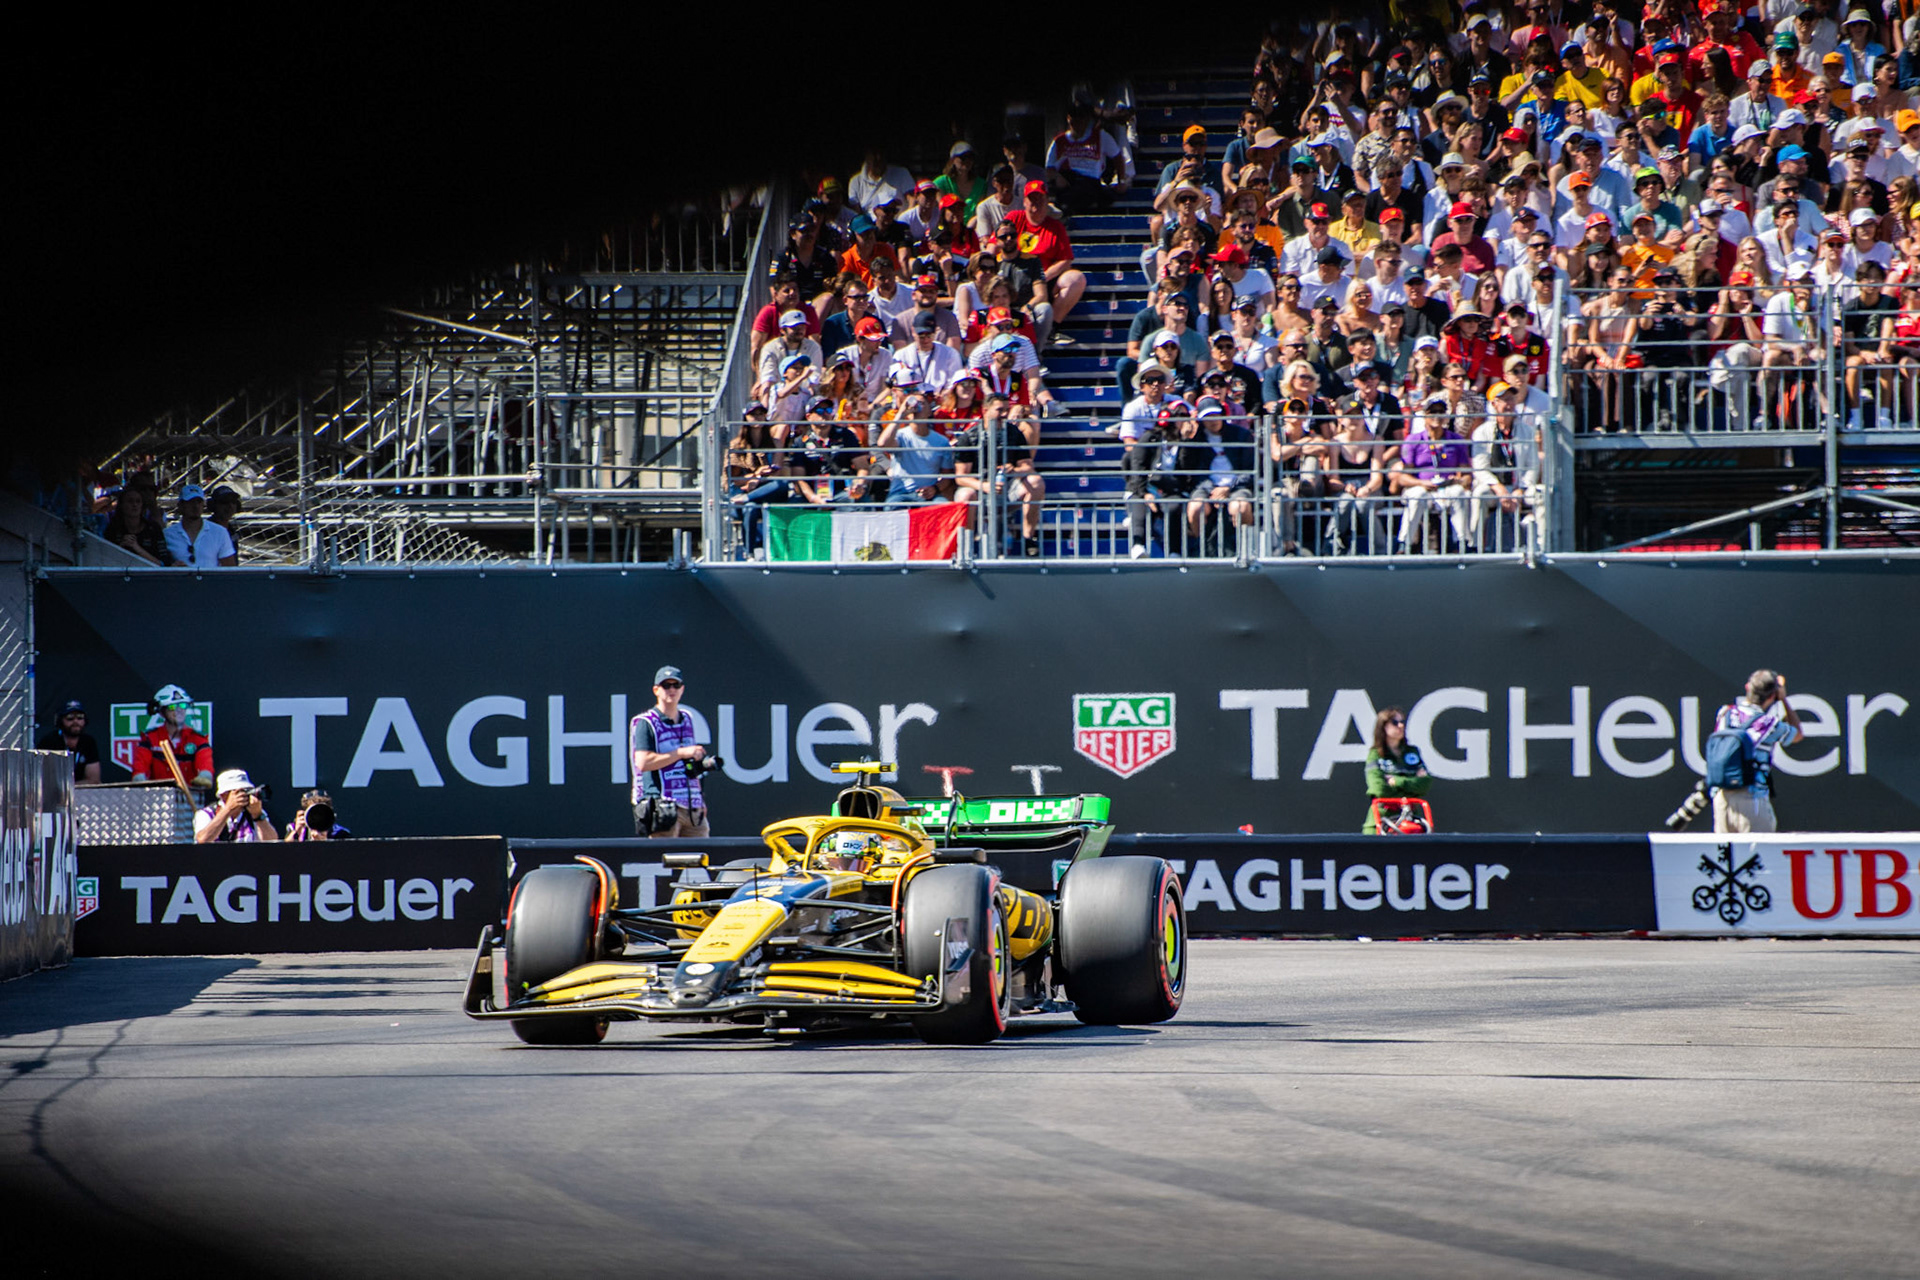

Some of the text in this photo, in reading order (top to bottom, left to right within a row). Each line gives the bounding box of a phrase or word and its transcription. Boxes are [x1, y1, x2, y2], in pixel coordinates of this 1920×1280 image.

[1082, 699, 1166, 726] TAG
[259, 693, 939, 787] TAGHuer
[1080, 731, 1169, 771] HEUER
[1168, 858, 1510, 912] AGHeuer
[1783, 849, 1920, 919] UB
